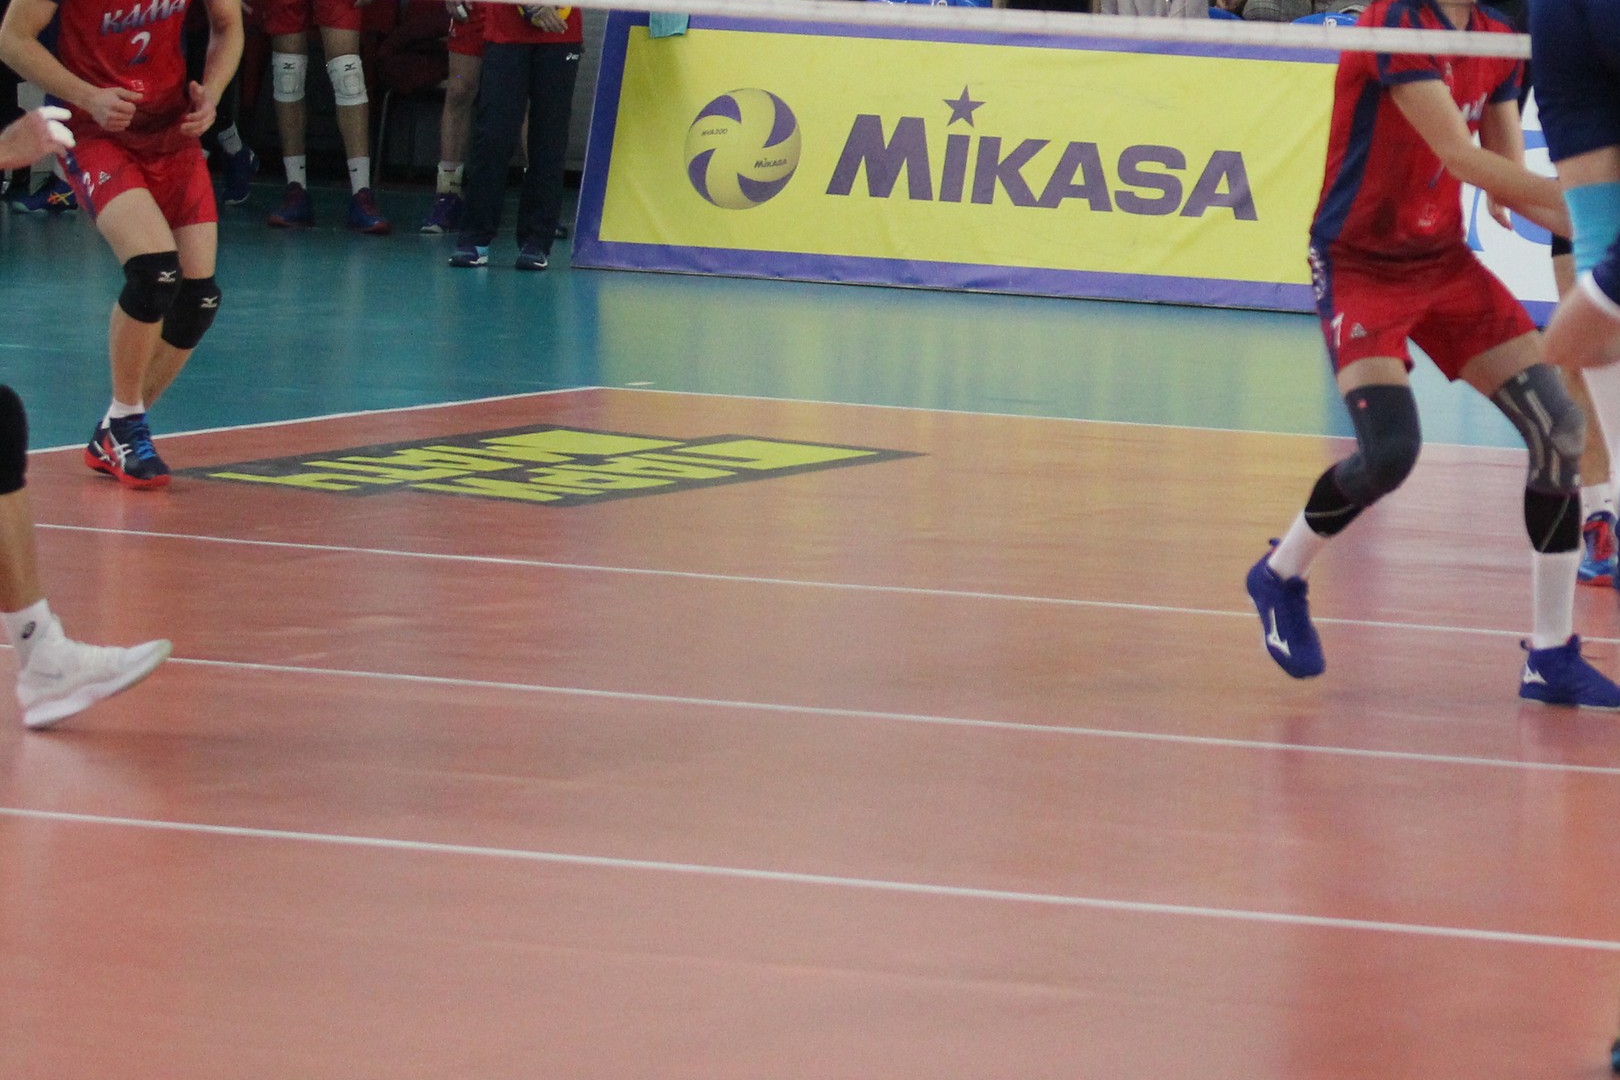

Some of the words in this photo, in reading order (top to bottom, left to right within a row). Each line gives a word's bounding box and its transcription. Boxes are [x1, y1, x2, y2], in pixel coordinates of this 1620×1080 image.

[127, 31, 151, 65] 2
[825, 84, 1258, 221] MIKASA
[209, 429, 688, 491] МАТЧ
[409, 439, 879, 502] ПАРИ
